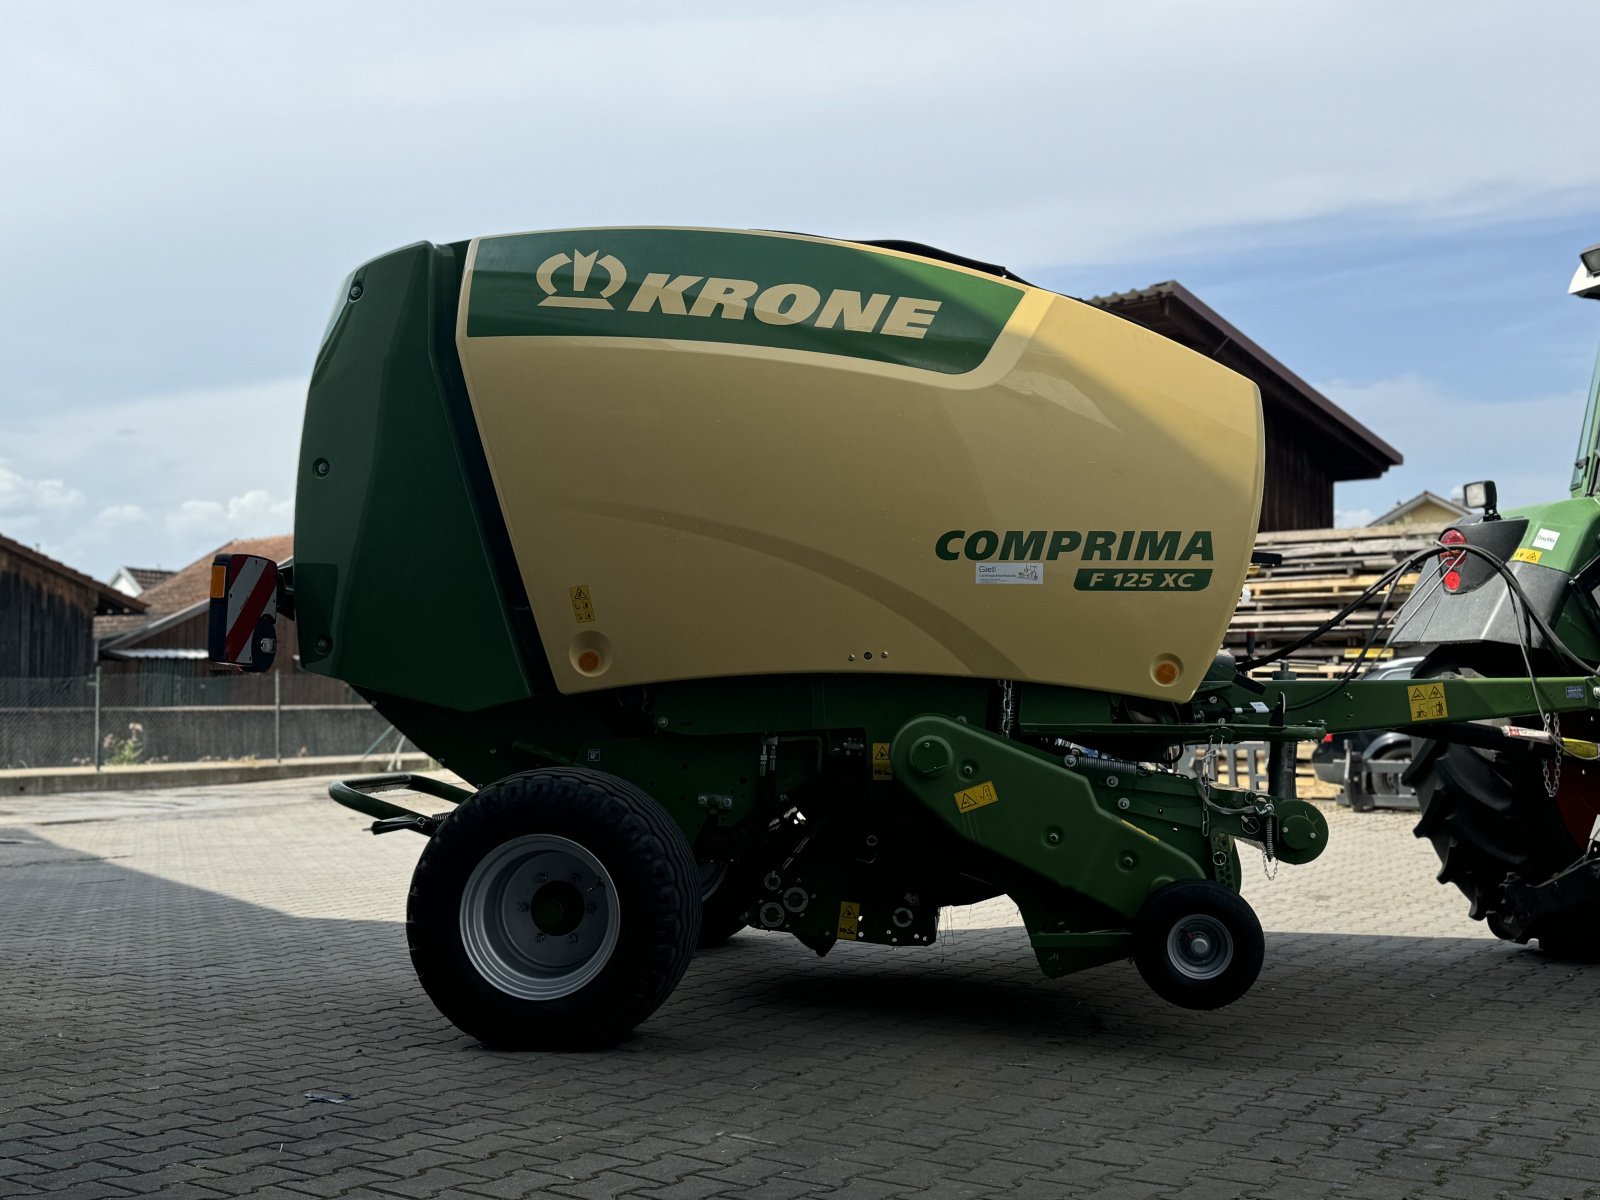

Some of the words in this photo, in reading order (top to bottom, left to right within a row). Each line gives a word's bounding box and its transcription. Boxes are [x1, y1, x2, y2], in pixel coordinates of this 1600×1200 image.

[627, 272, 942, 339] KRONE
[935, 530, 1214, 561] COMPRIMA
[1089, 572, 1105, 587] F
[1112, 572, 1153, 588] 125
[1159, 572, 1195, 588] XC
